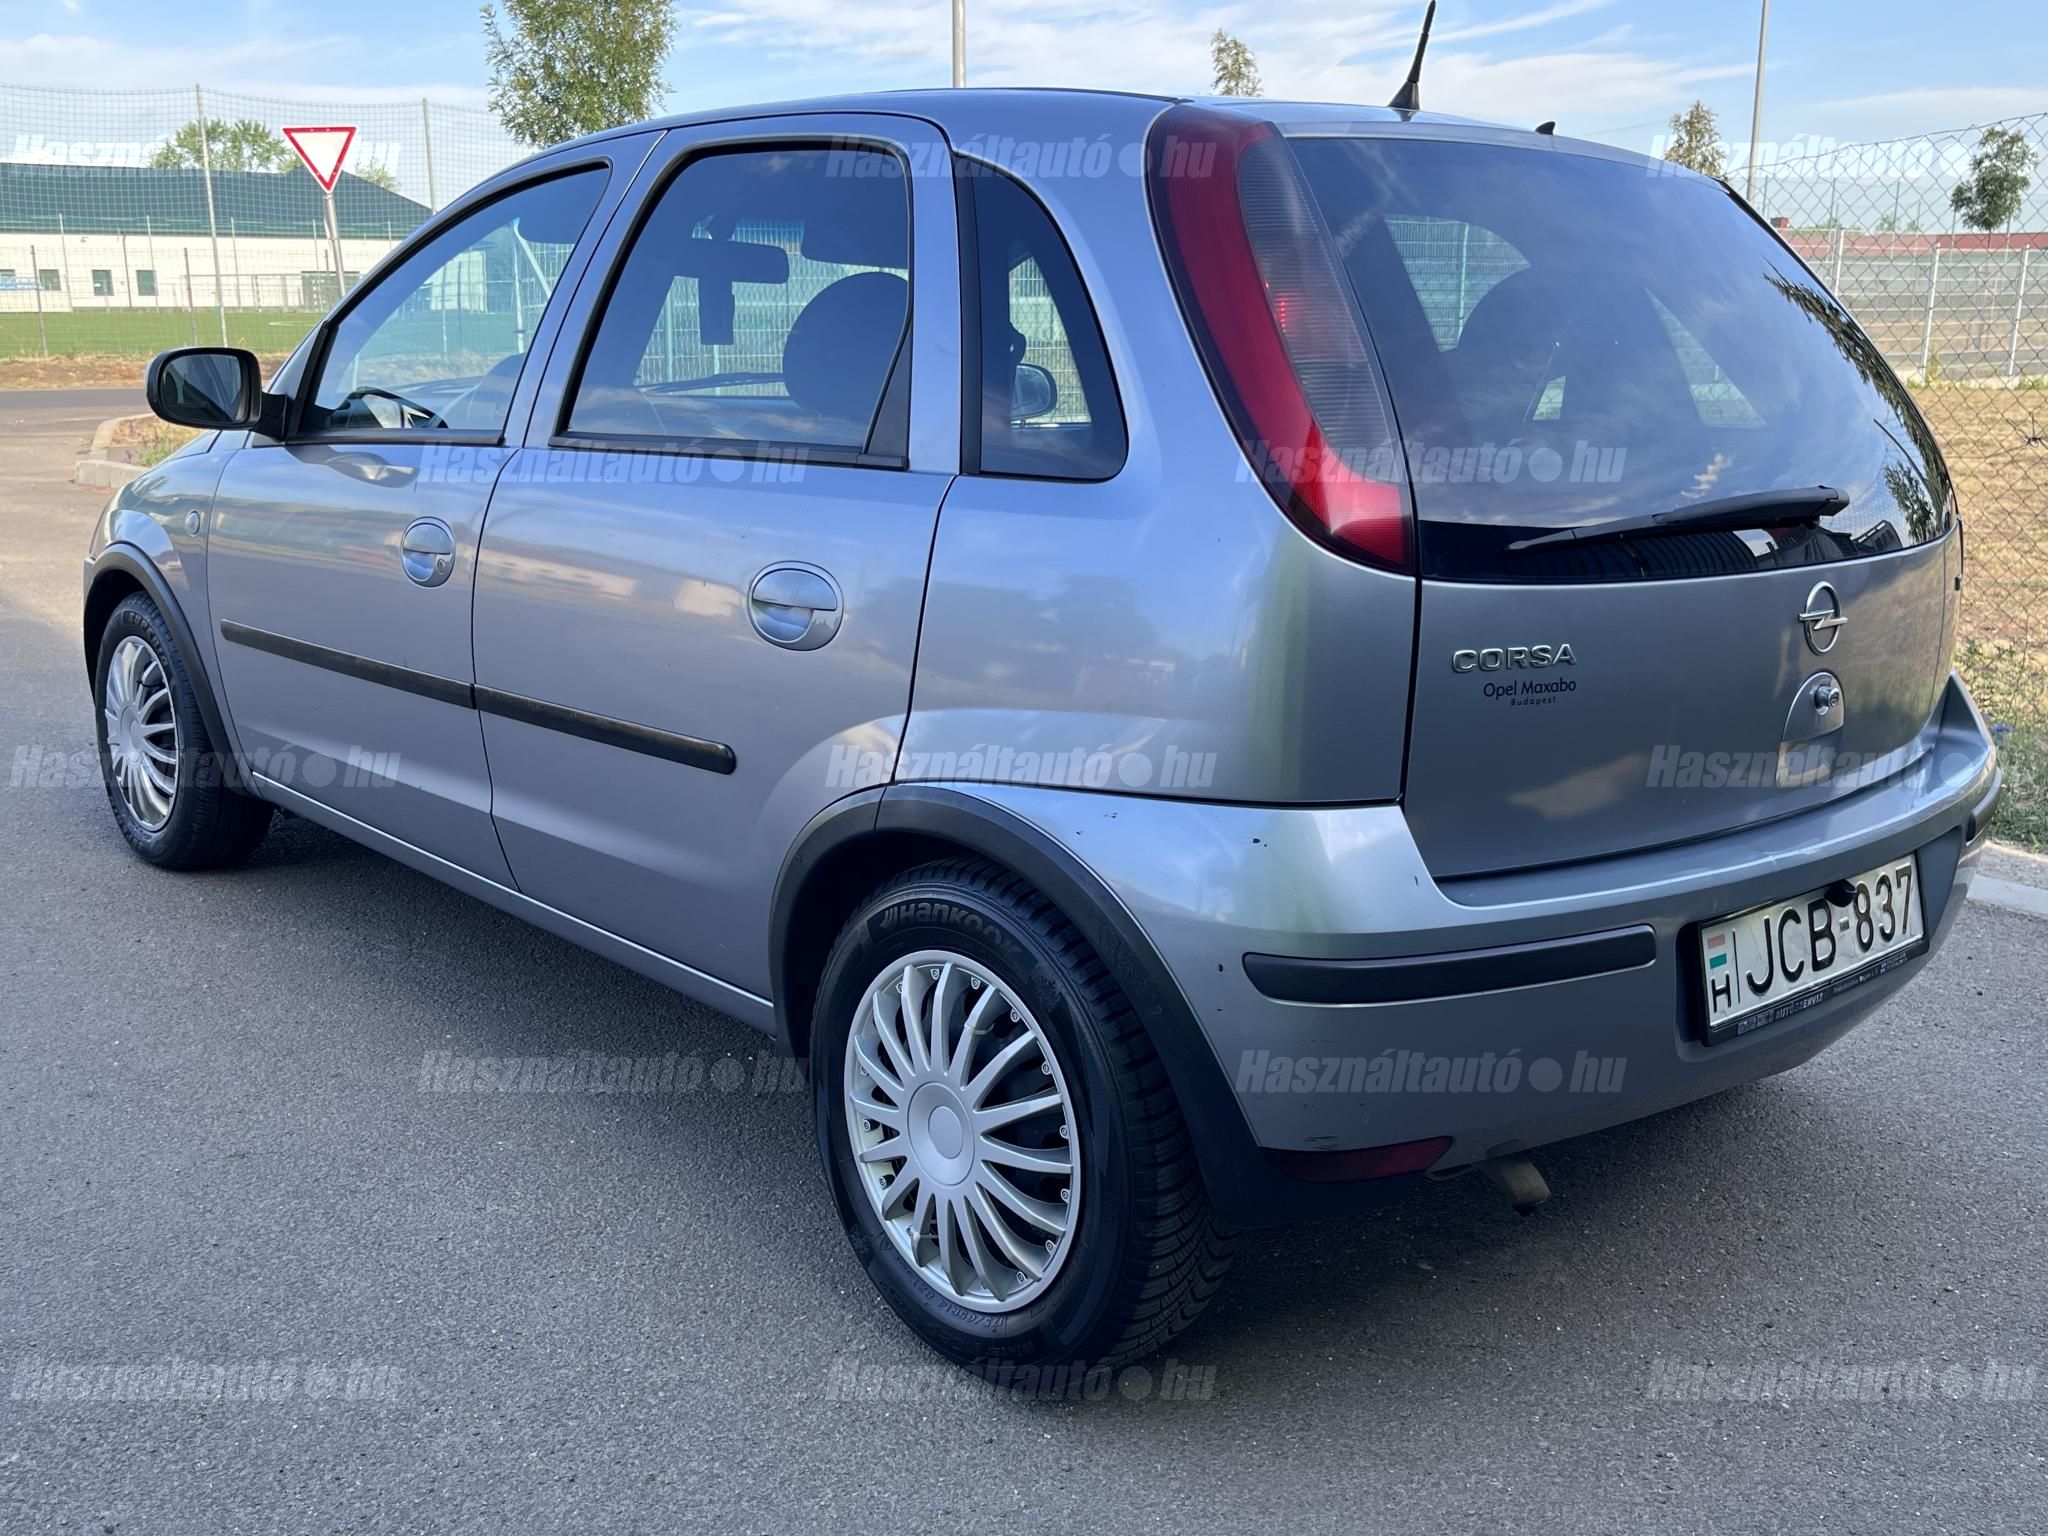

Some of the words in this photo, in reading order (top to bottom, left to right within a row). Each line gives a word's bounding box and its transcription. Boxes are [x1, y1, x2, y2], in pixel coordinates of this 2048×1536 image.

[1452, 643, 1577, 673] CORSA
[1483, 680, 1517, 700] Opel
[1521, 677, 1577, 694] Maxabo
[1511, 696, 1556, 706] Budapest
[1711, 972, 1731, 1013] H
[1746, 862, 1912, 996] JCB-837
